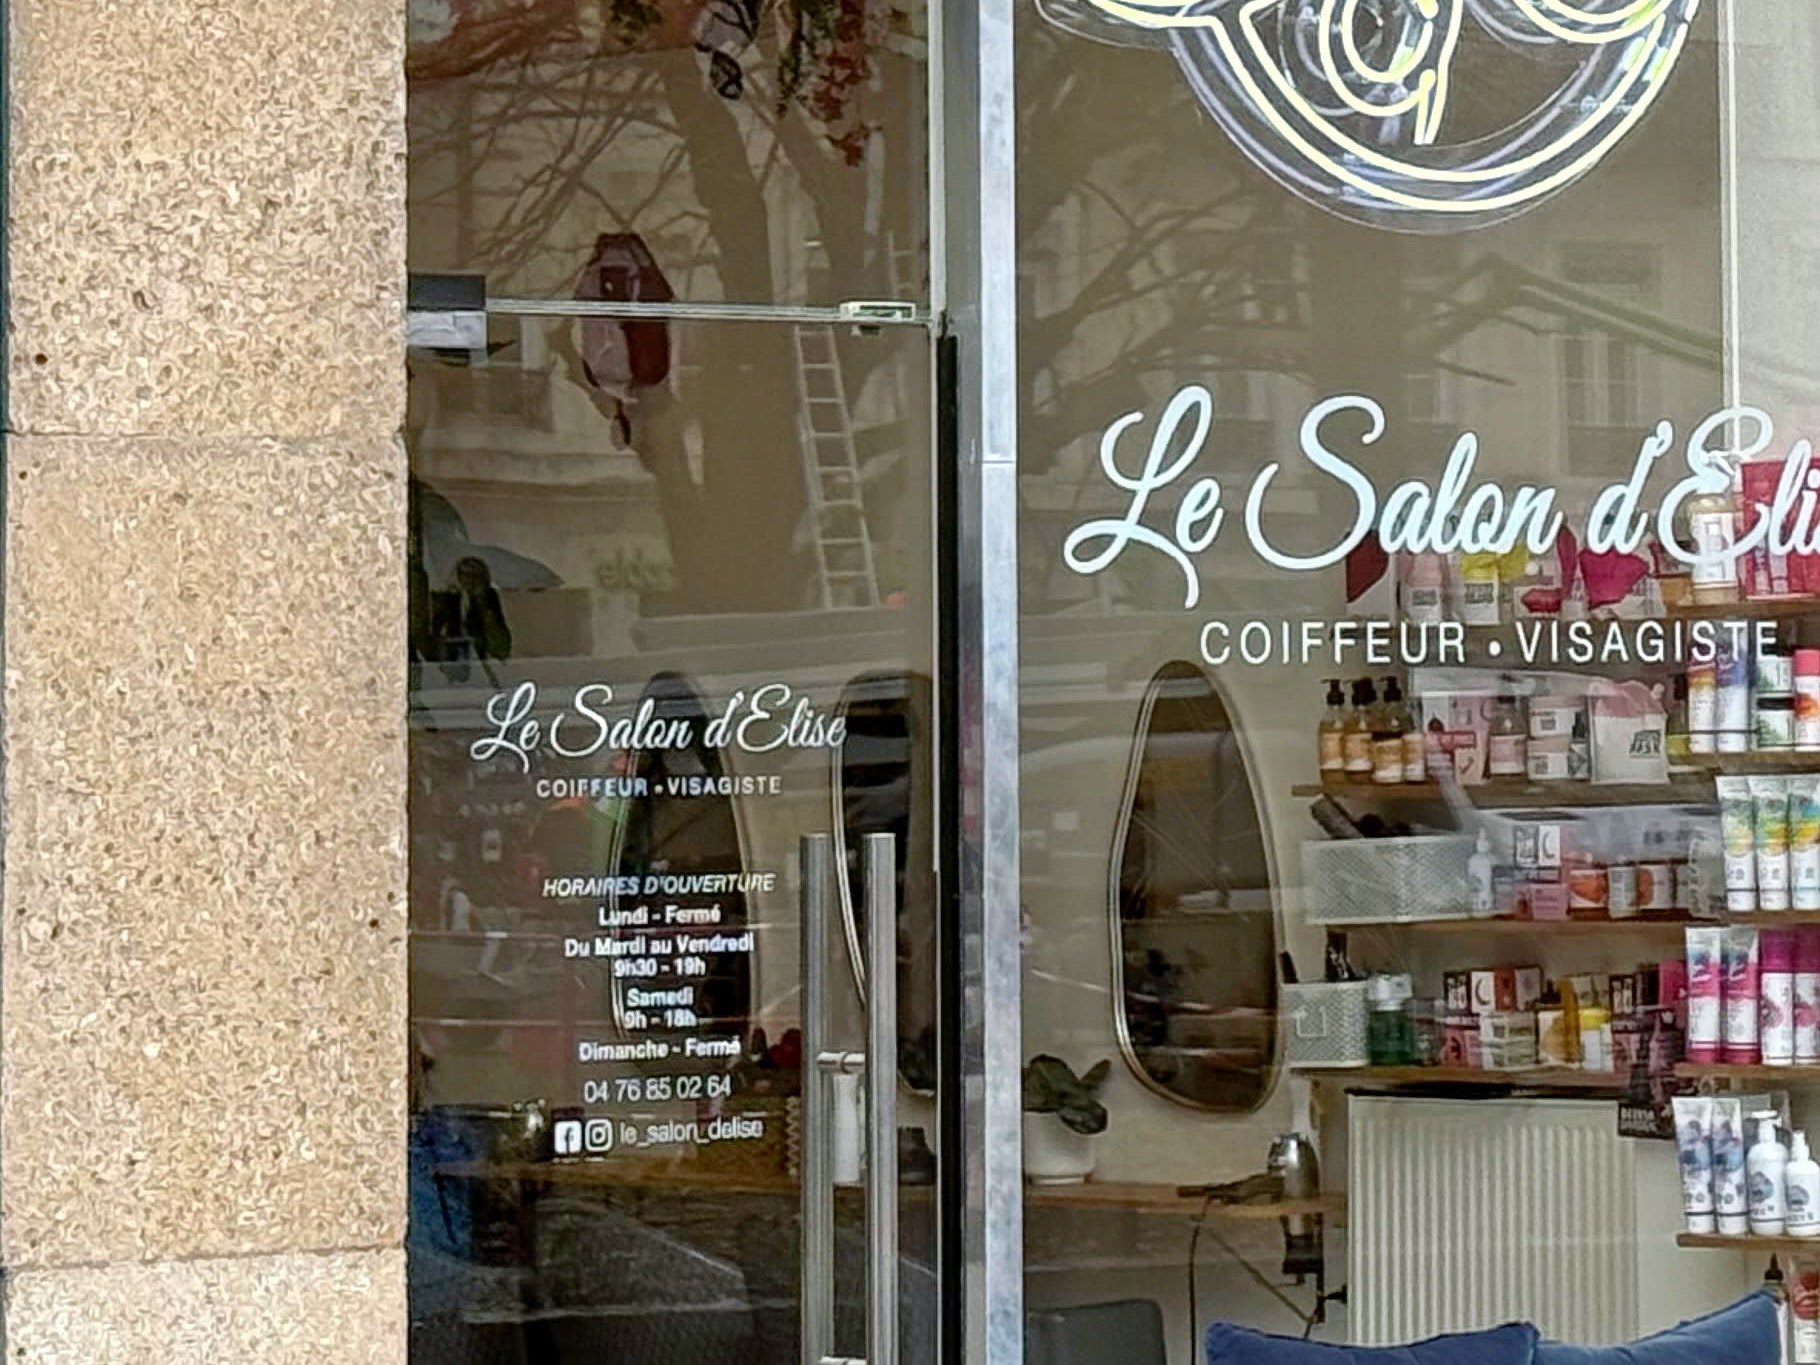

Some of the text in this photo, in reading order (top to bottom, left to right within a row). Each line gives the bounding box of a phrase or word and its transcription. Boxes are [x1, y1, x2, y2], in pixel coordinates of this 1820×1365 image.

[1062, 384, 1225, 610] Le
[1245, 395, 1564, 571] Salon
[1201, 621, 1466, 665] COIFFEUR
[1520, 620, 1778, 663] VISAGISTE
[470, 682, 540, 772] Le
[549, 684, 693, 757] Salon
[536, 776, 648, 798] COIFFEUR
[667, 775, 781, 797] VISAGISTE
[542, 873, 776, 897] HORAIRES D'OUVERTURE
[599, 906, 648, 926] Lundi
[665, 904, 721, 924] Fermé
[564, 933, 754, 957] Du Mardi au Vendredi
[614, 959, 657, 977] 9h30
[675, 957, 706, 976] 19h
[627, 987, 694, 1007] Samedi
[624, 1011, 647, 1029] 9h
[664, 1009, 697, 1028] 18h
[579, 1041, 668, 1062] Dimanche
[685, 1036, 741, 1057] Fermé
[584, 1075, 731, 1103] 04 76 85 02 64
